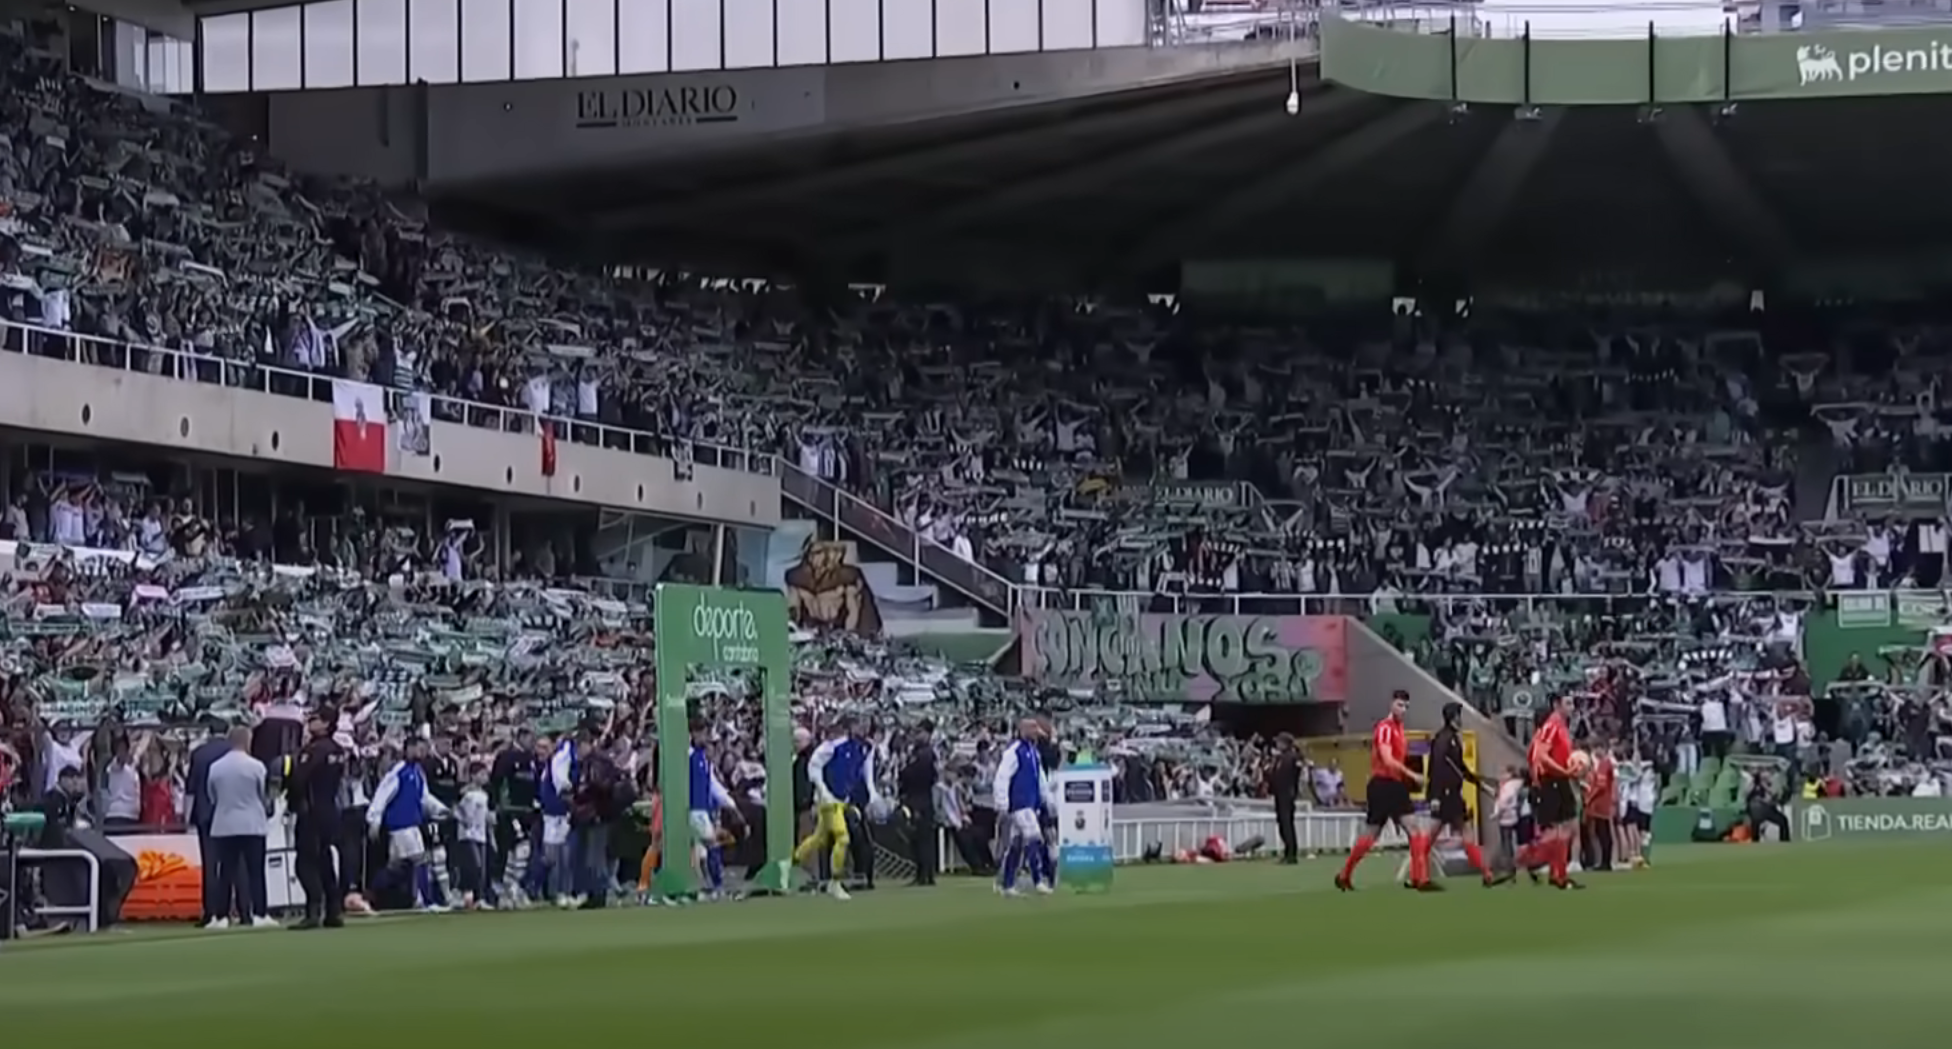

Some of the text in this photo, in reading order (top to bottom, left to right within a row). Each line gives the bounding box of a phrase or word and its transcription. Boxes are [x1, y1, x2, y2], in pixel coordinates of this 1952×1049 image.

[577, 85, 737, 119] EL DIARIO
[1879, 480, 1943, 496] DARIO
